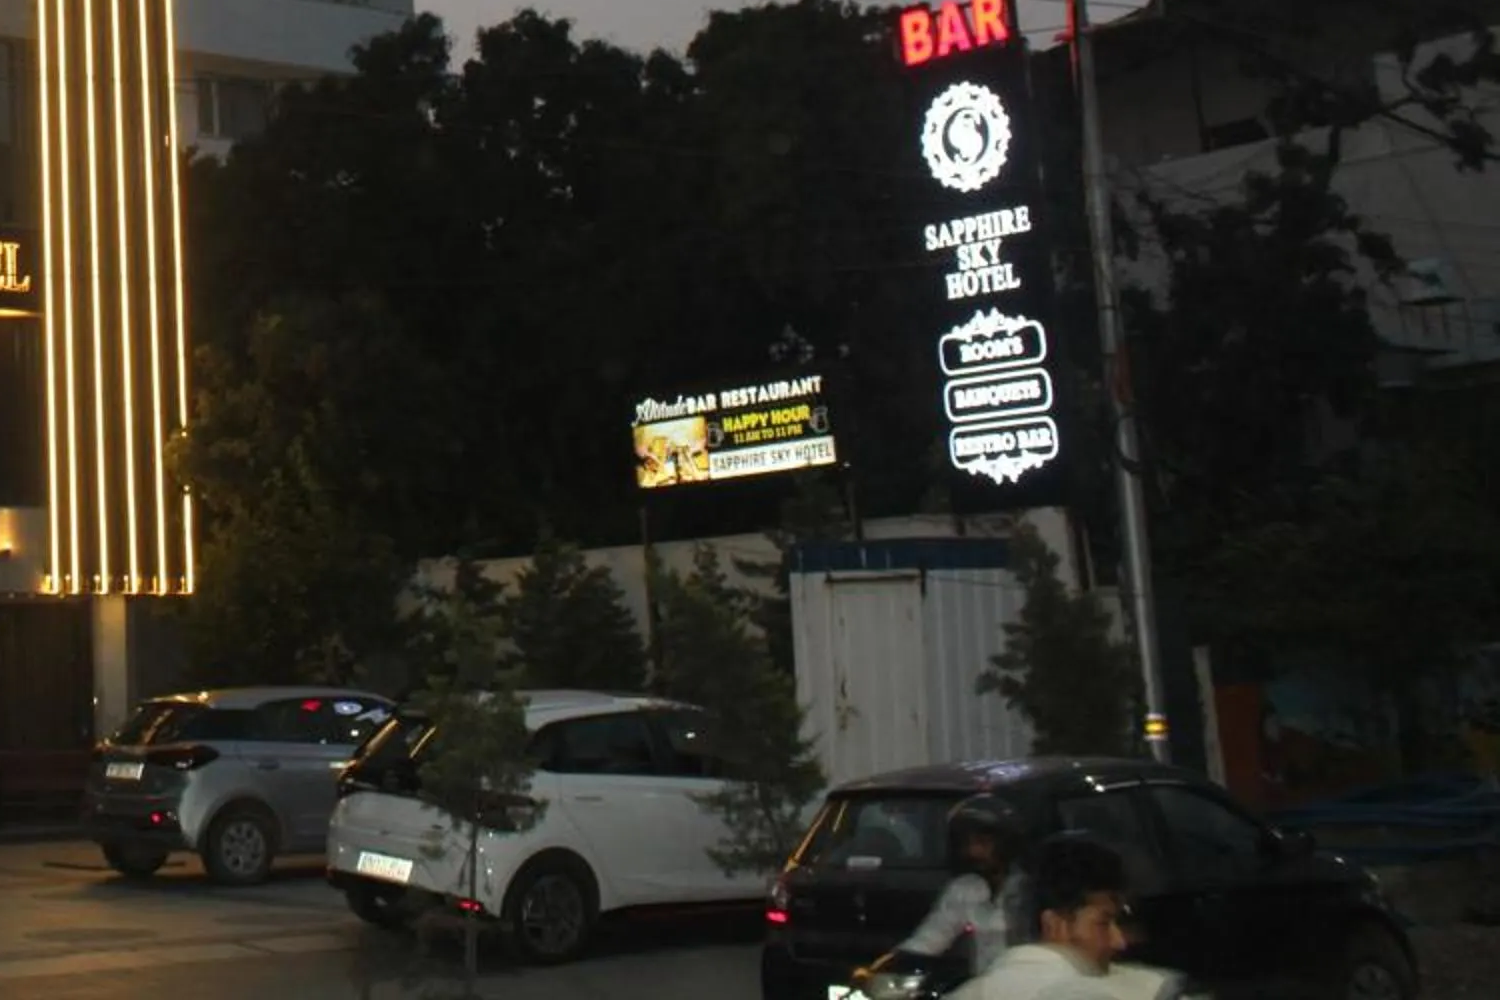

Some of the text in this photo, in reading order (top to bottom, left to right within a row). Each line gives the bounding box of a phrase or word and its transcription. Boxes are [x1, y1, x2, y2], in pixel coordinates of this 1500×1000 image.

[924, 205, 1032, 250] SAPPHIRE
[956, 238, 1003, 271] SKY
[945, 264, 1021, 299] HOTEL
[686, 394, 717, 414] BAR
[720, 376, 822, 409] RESTAURANT
[723, 405, 812, 432] HAPPY HOUR
[1016, 428, 1053, 449] BAR
[713, 444, 834, 471] SAPPHIRE SKY HOTEL
